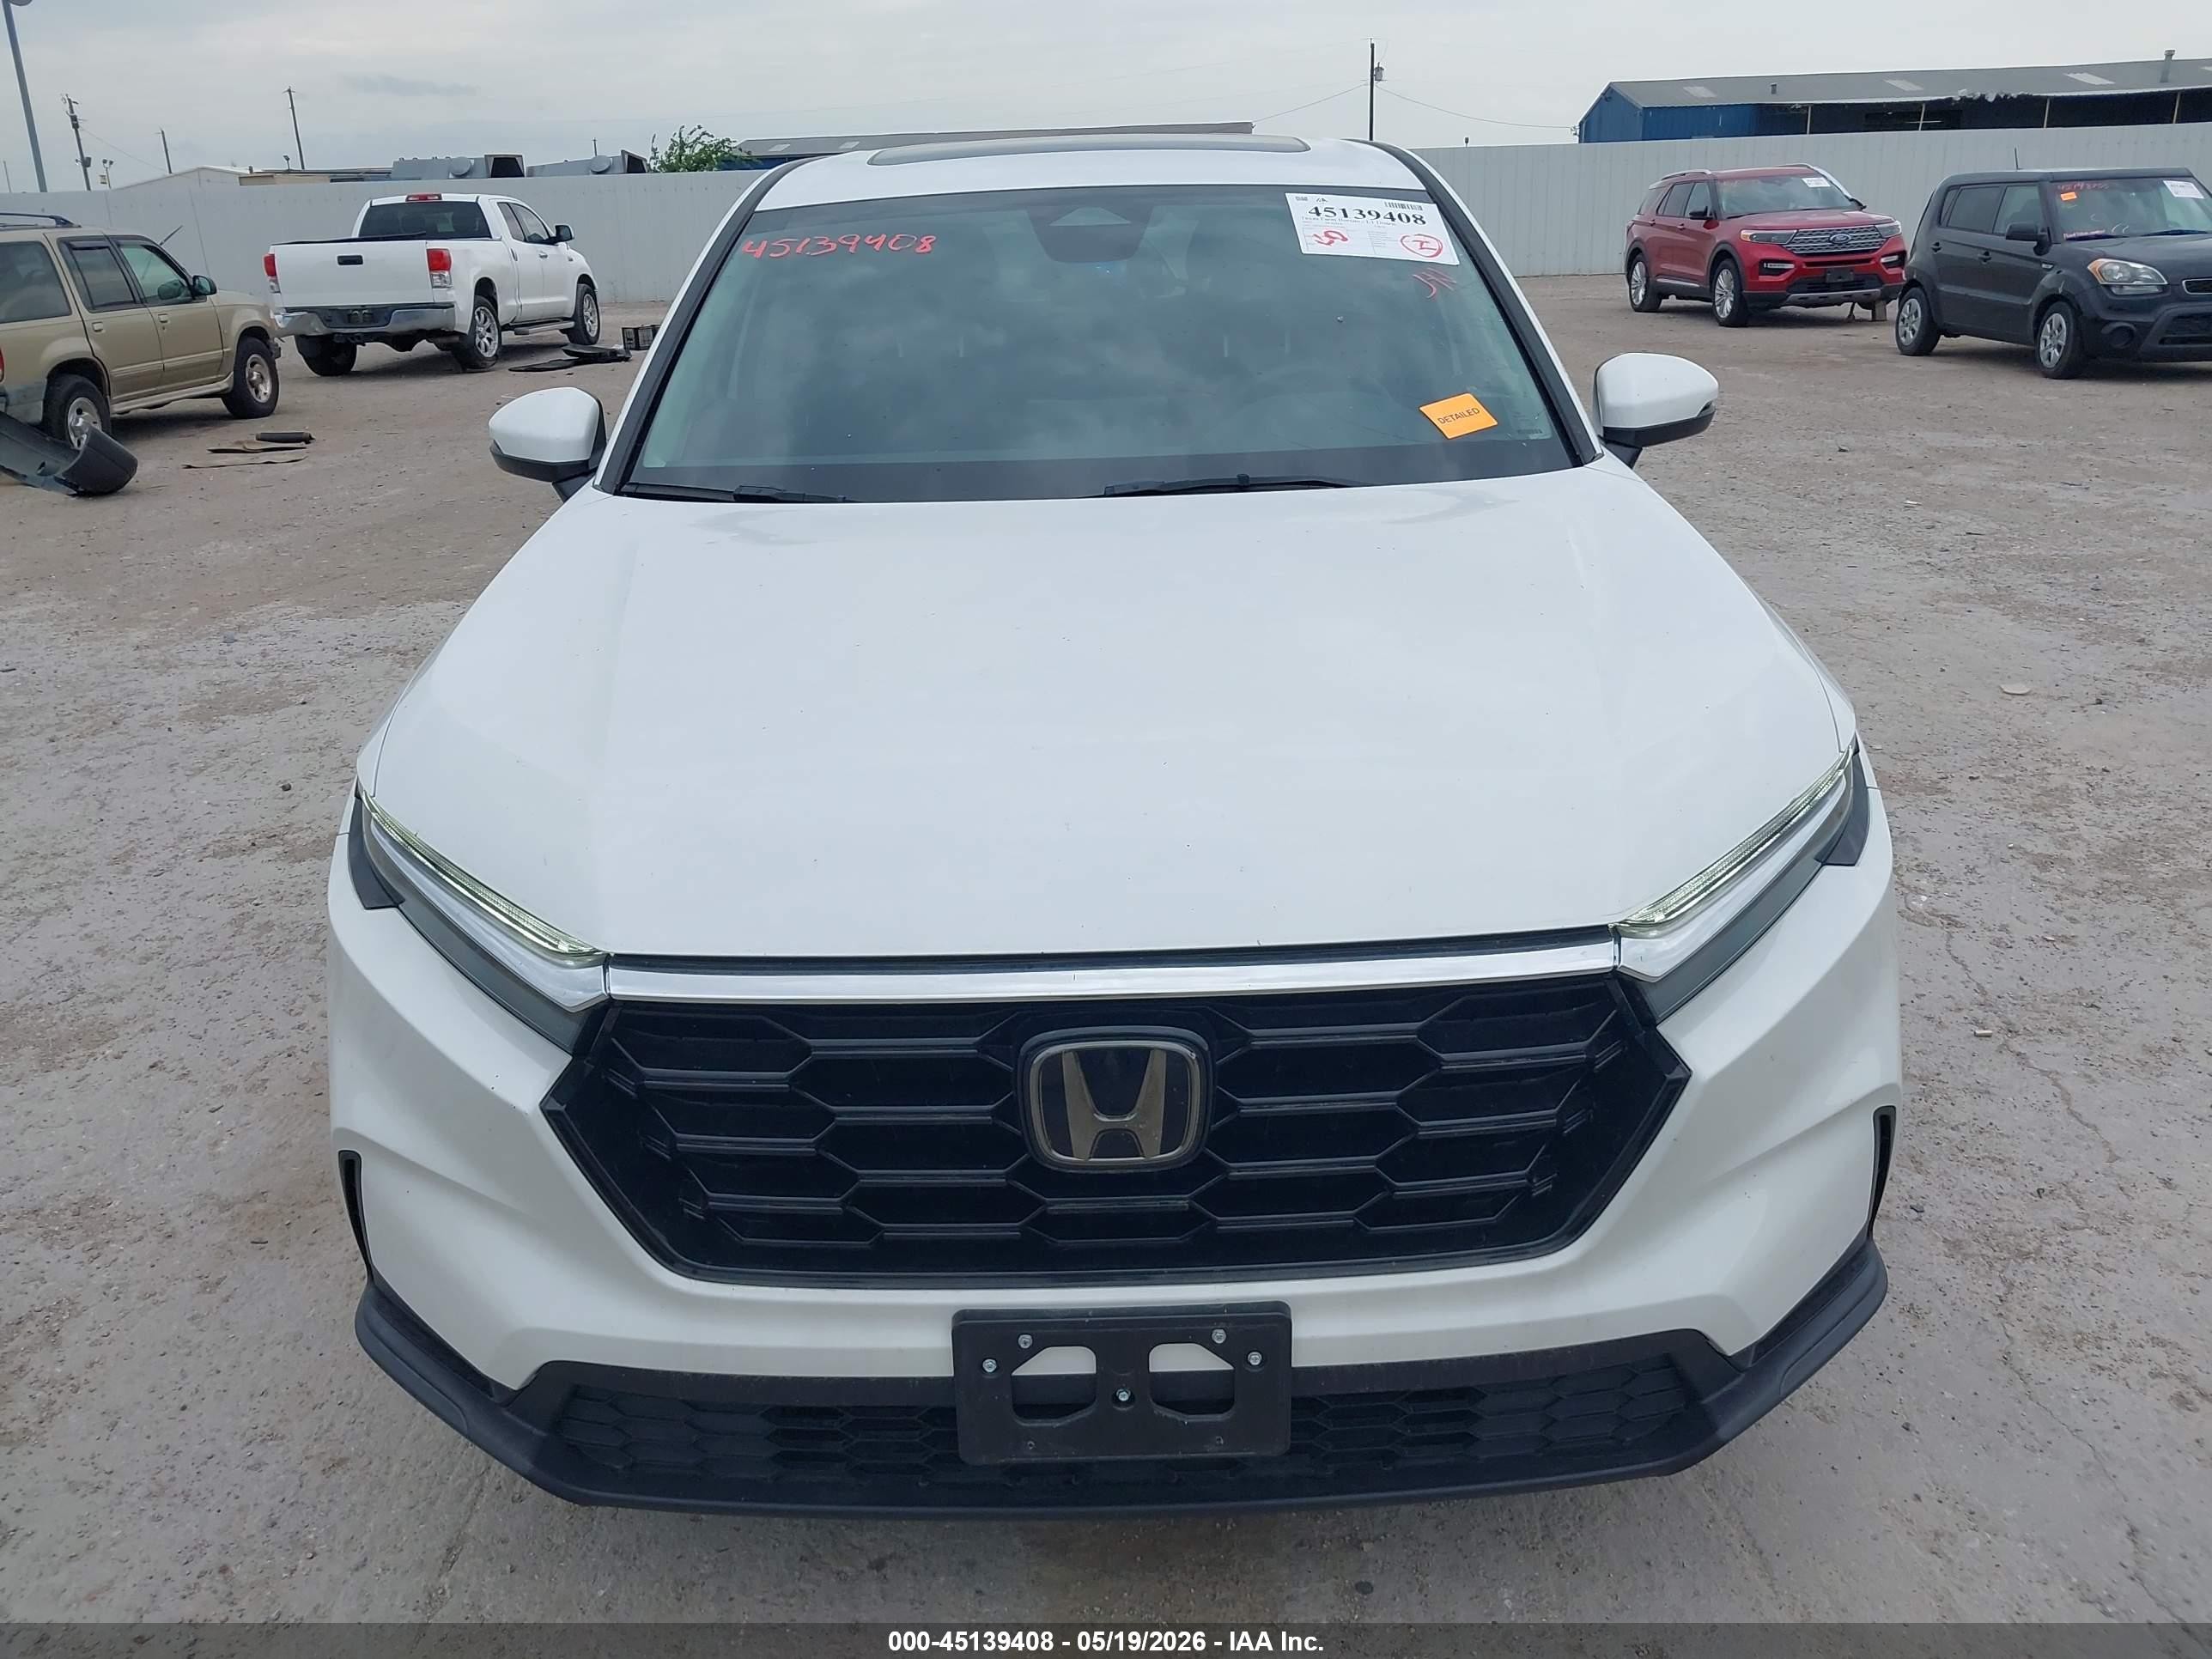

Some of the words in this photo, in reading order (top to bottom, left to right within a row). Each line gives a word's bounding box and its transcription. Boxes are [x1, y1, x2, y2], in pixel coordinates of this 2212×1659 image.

[1309, 205, 1427, 226] 45139408
[741, 233, 937, 259] 45139408
[1437, 407, 1480, 424] DETAILED
